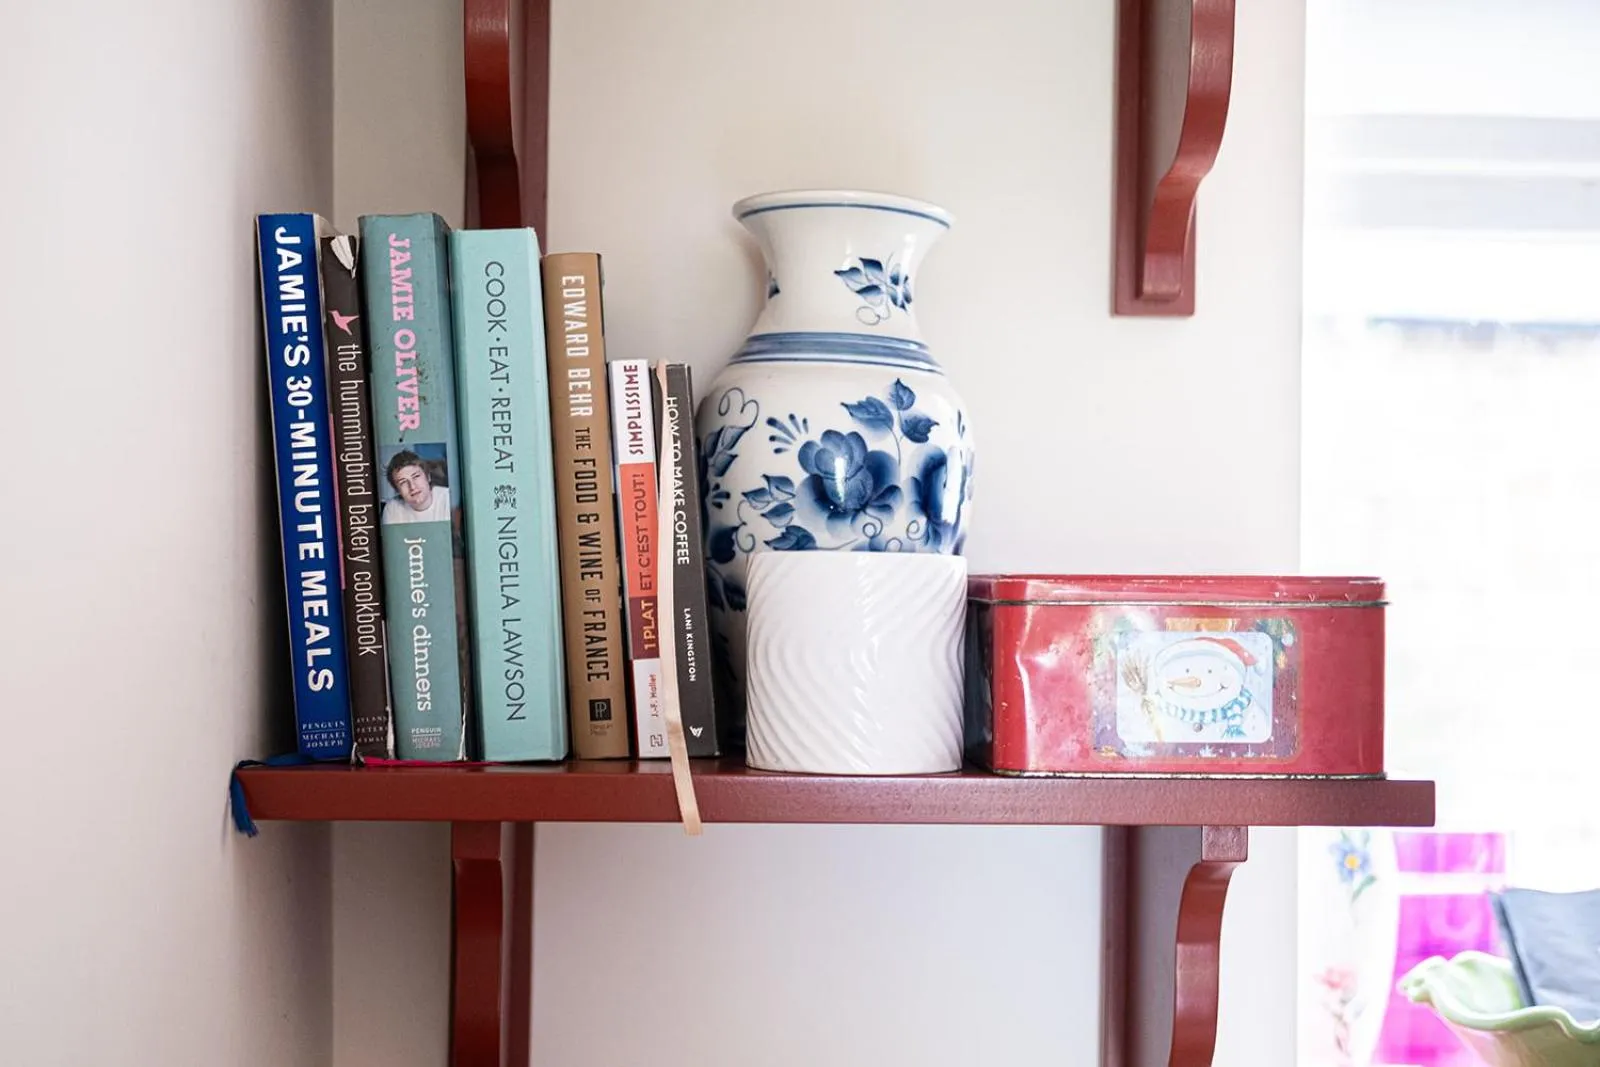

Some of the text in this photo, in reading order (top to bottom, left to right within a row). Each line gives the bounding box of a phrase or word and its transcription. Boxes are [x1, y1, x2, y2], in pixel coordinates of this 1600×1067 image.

[388, 233, 421, 432] JAMIE OLIVER
[623, 364, 644, 455] SIMPLISSIME
[274, 226, 334, 692] JAMIE'S 30-MINUTE MEALS
[337, 343, 383, 657] the hummingbird bakery cookbook
[485, 261, 527, 721] COOK EAT REPEAT NIGELLA LAWSON
[562, 275, 610, 682] EDWARD BEHR THE FOOD & WINE OF FRANCE
[666, 396, 690, 566] HOW TO MAKE COFFEE
[404, 537, 432, 712] jamie's dinners
[632, 473, 656, 651] 1 PLAT ET C'EST TOUT!
[684, 608, 697, 682] LANI KINGSTON
[302, 720, 345, 731] PENGUIN
[302, 731, 346, 741] MICHAEL
[306, 739, 344, 749] JOSEPH
